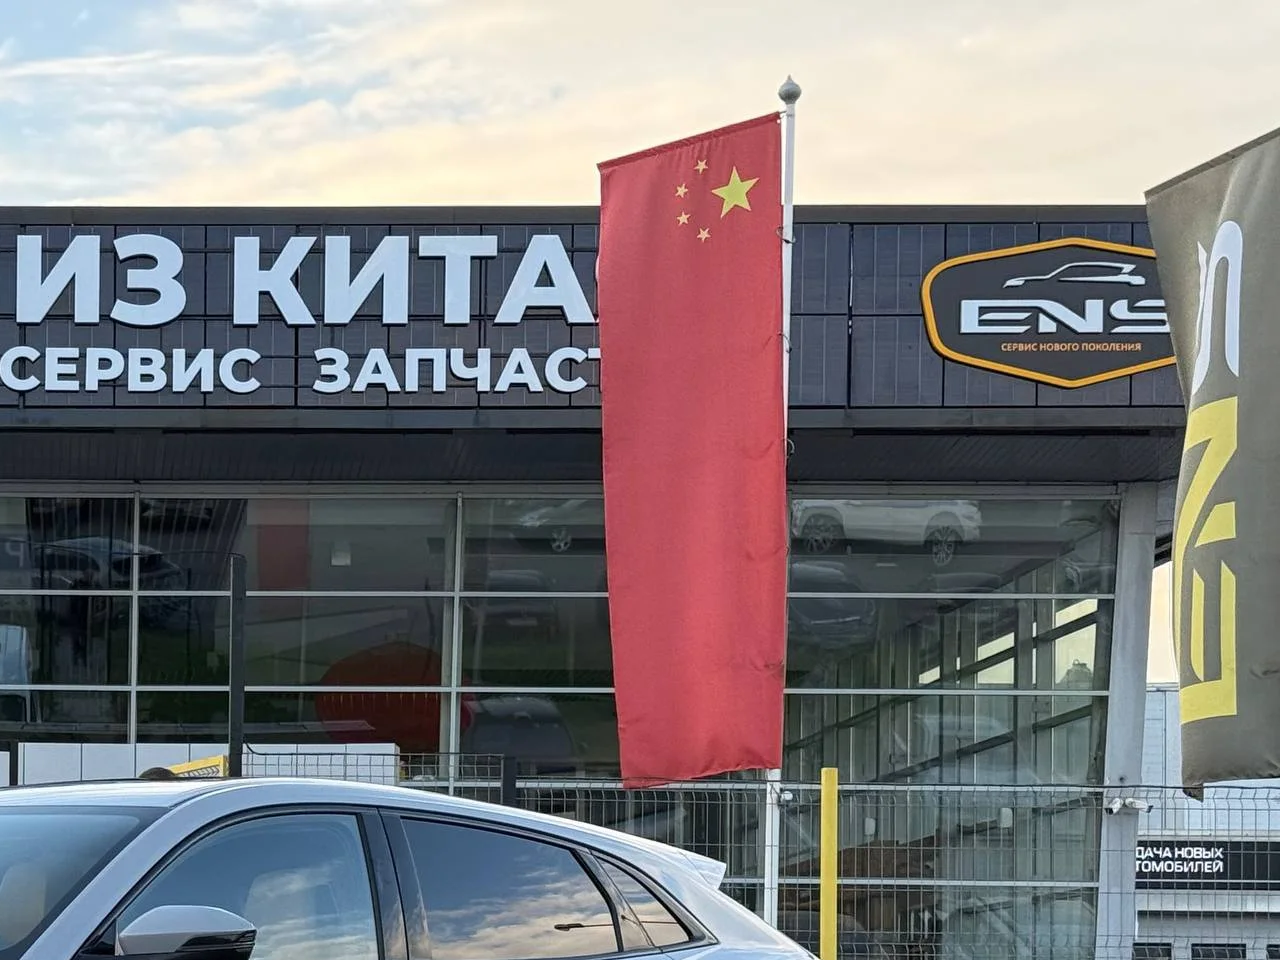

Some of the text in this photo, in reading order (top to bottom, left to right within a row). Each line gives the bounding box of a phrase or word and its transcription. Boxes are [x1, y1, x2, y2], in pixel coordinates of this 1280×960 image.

[15, 234, 187, 327] ИЗ
[232, 234, 598, 326] КИТА
[960, 300, 1171, 334] ENS
[1001, 342, 1142, 352] СЕРВИС НОВОГО ПОКОЛЕНИЯ
[0, 345, 261, 393] СЕРВИС
[1174, 847, 1224, 859] НОВЫХ
